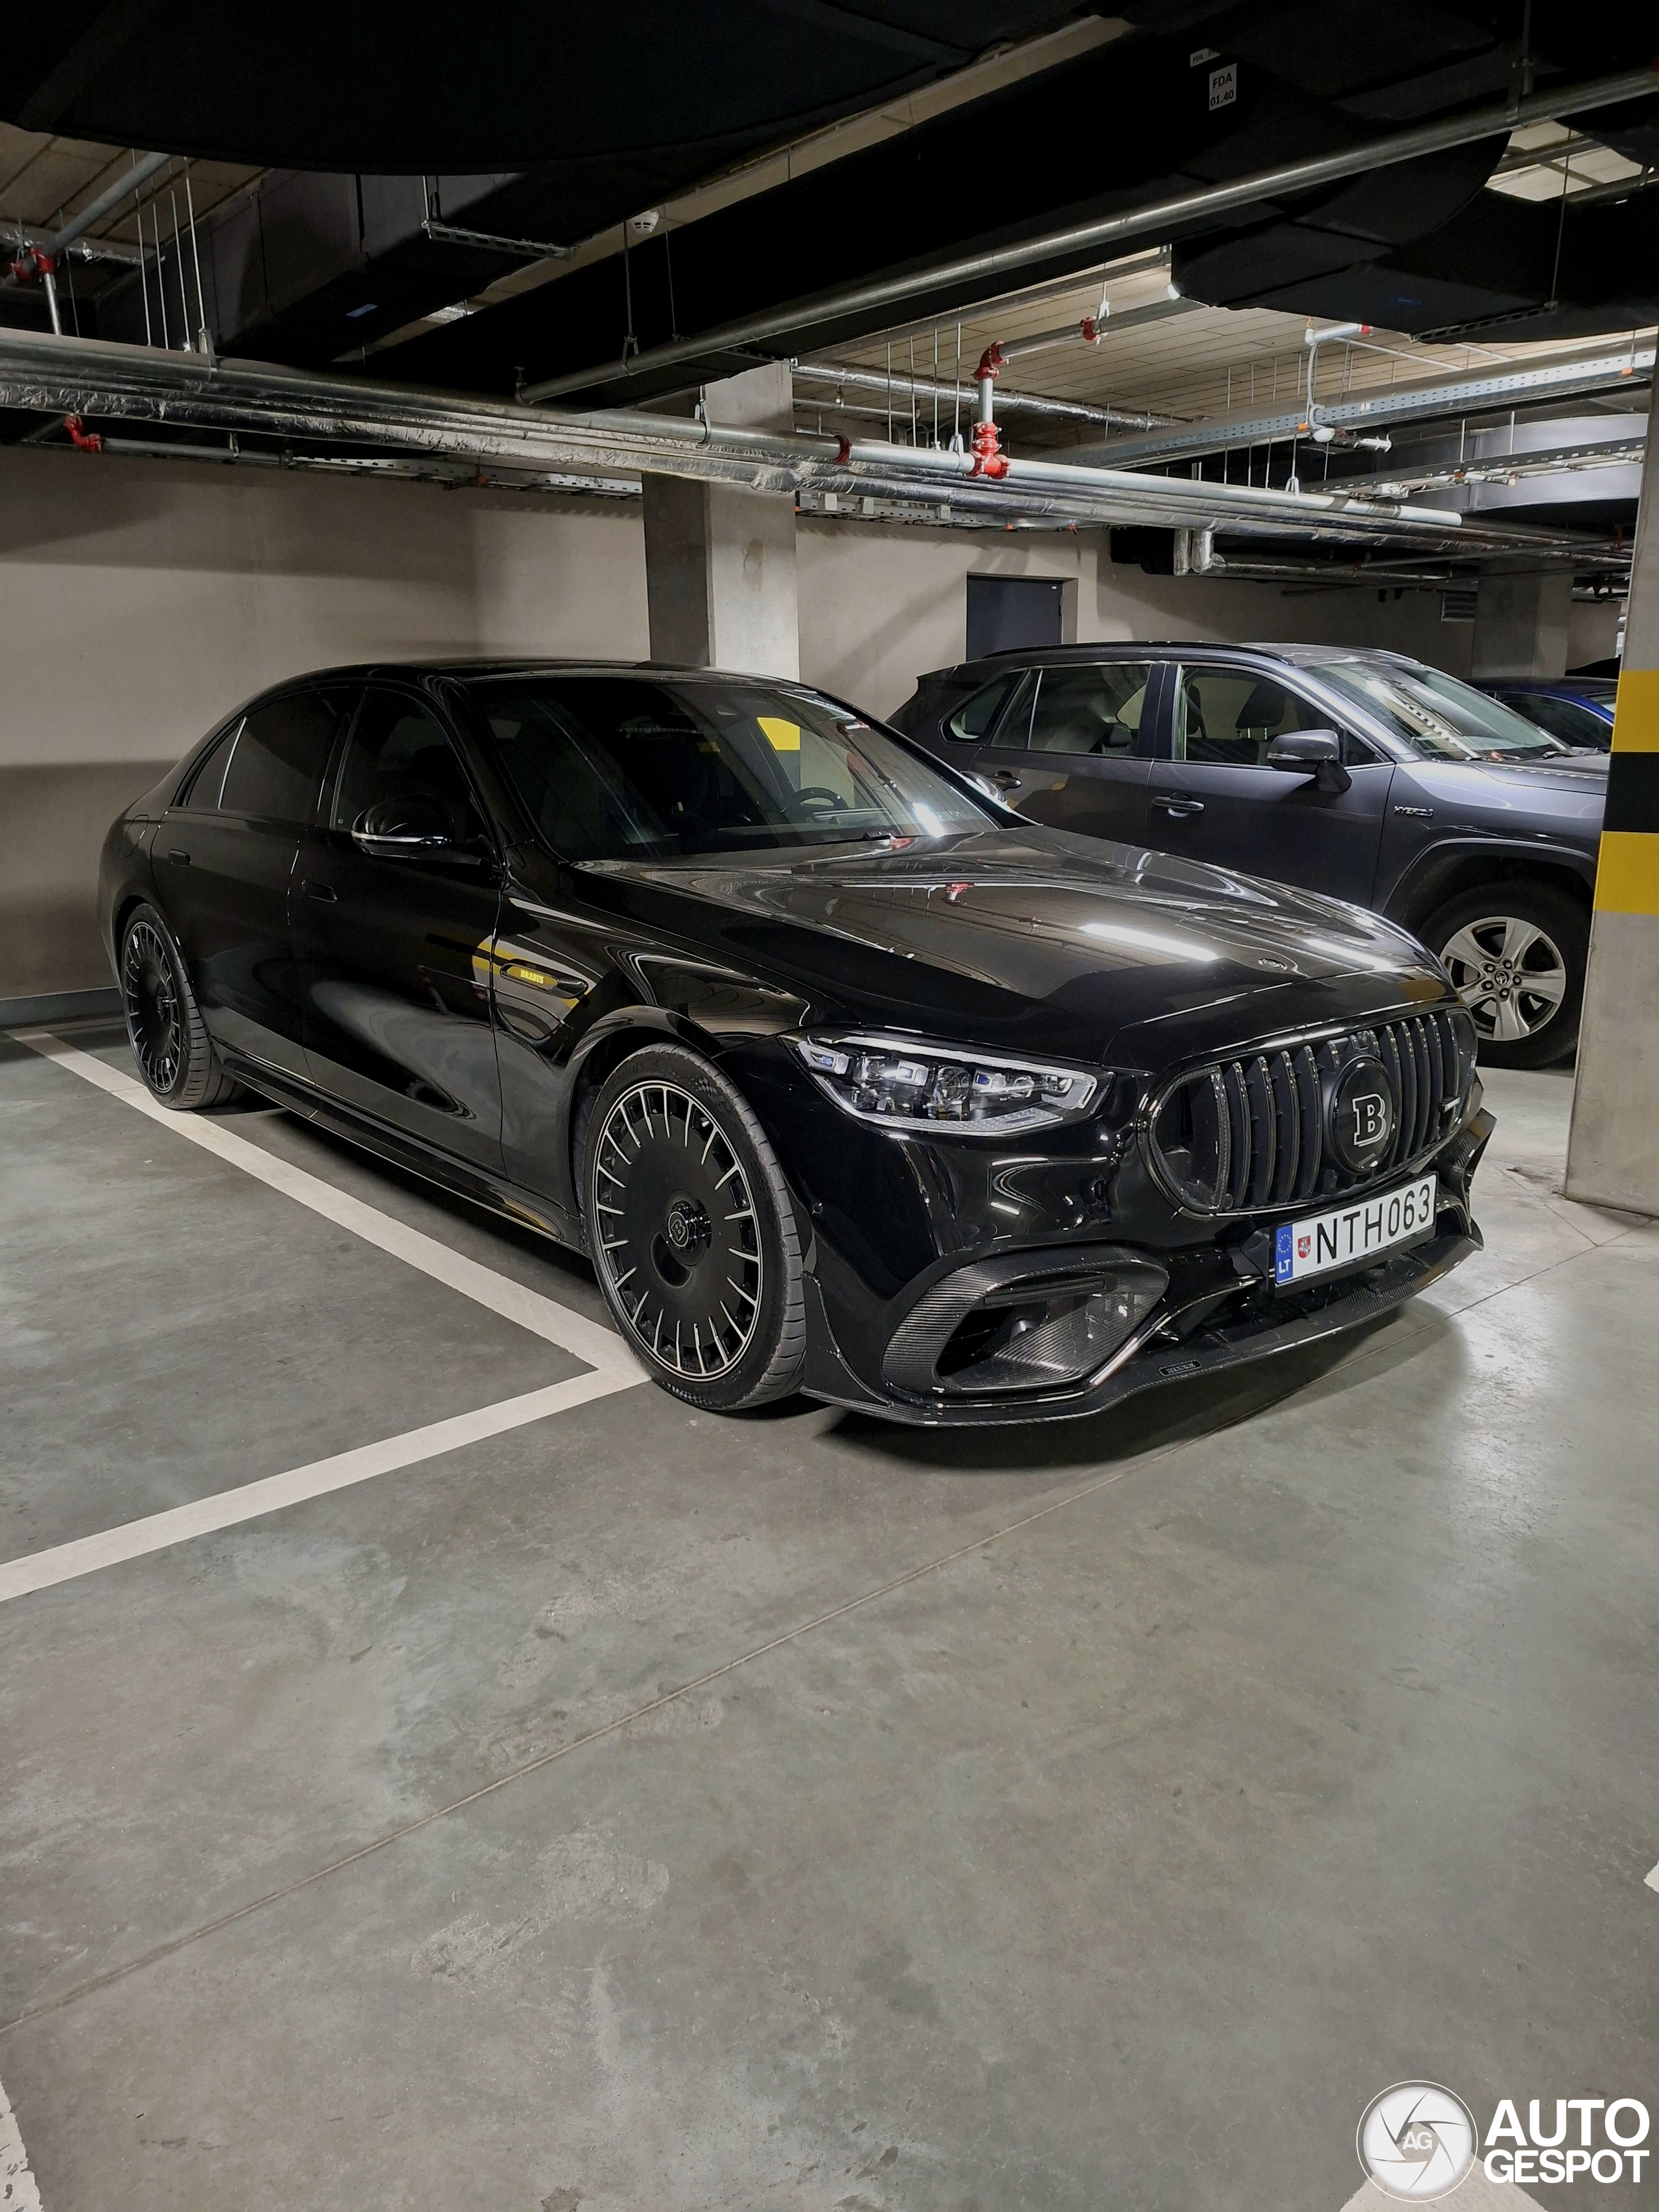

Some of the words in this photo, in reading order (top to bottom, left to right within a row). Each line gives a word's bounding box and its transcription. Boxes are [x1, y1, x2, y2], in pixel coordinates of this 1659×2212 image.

[1212, 72, 1233, 89] FDA
[1210, 89, 1234, 106] 01.40
[520, 970, 544, 984] BRABUS
[1352, 1093, 1386, 1147] B
[1317, 1183, 1430, 1264] NTH063
[1279, 1259, 1291, 1274] LT
